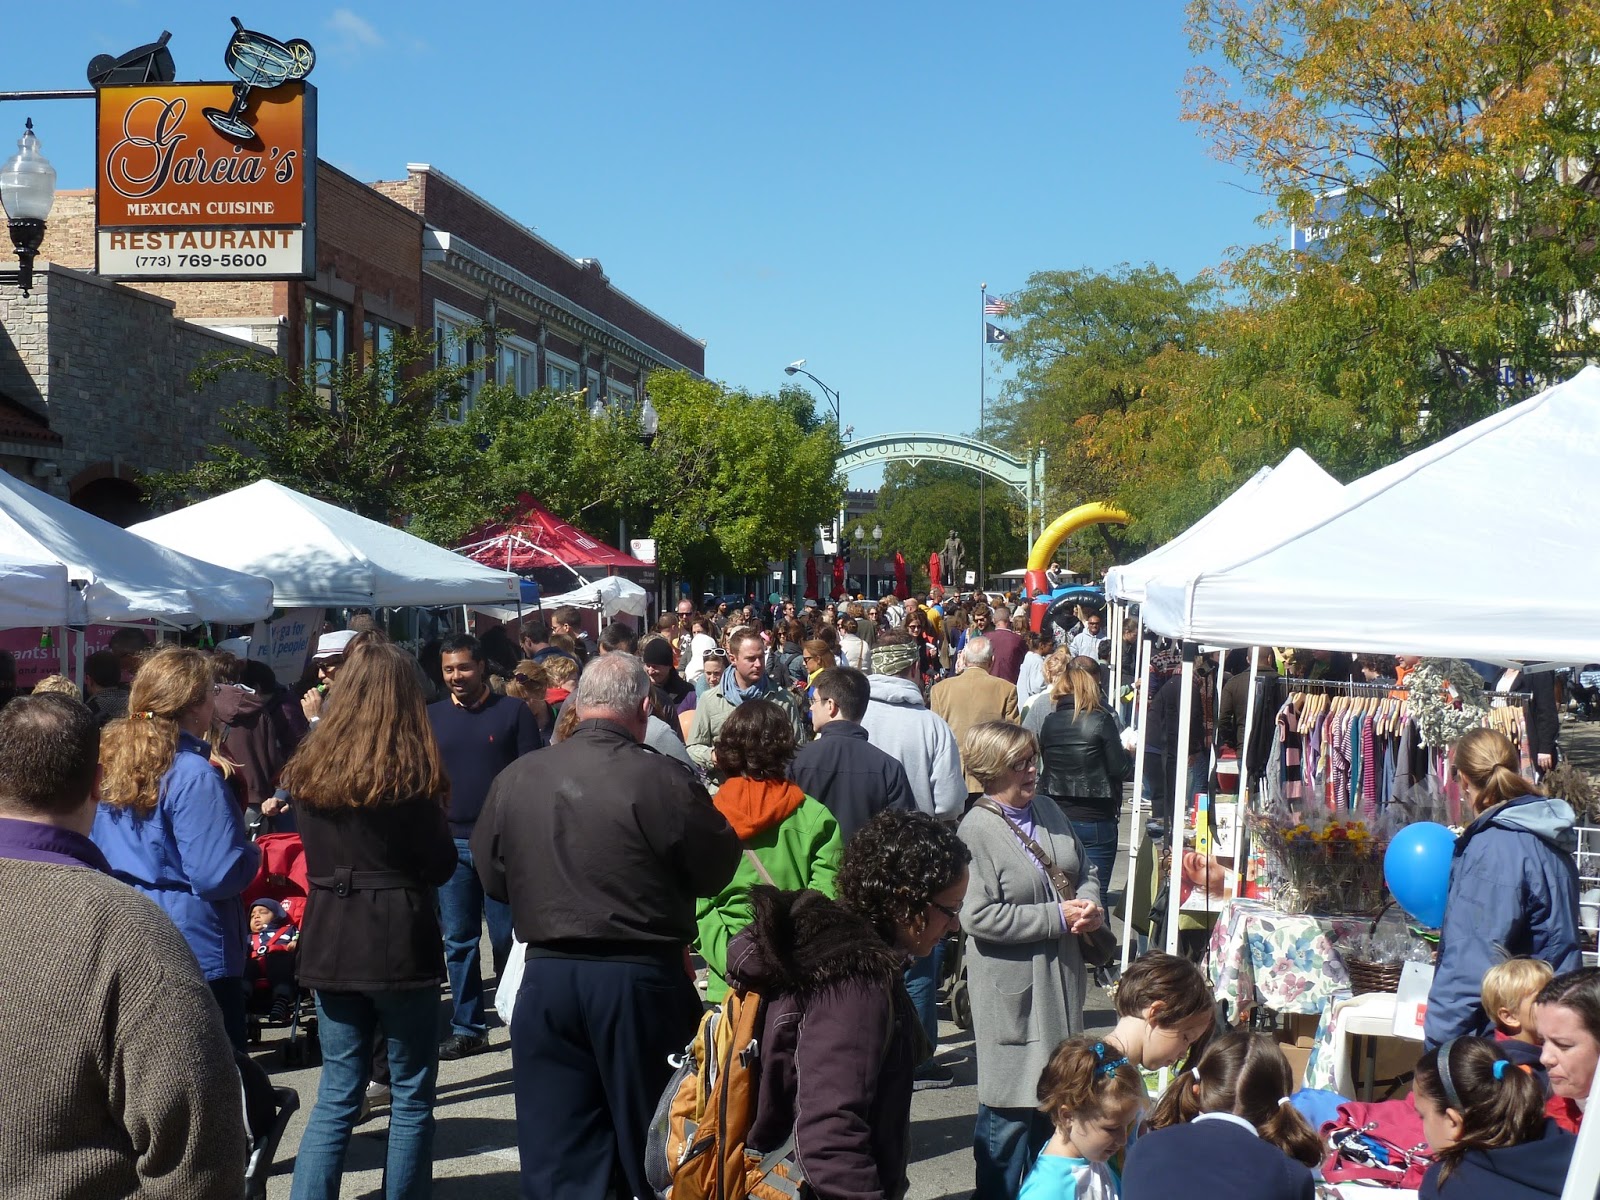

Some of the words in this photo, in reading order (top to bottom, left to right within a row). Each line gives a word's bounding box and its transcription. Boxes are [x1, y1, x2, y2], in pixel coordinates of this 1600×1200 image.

[106, 96, 297, 199] Garcia's
[127, 202, 201, 216] MEXICAN
[206, 201, 275, 215] CUISINE
[110, 230, 294, 250] RESTAURANT
[135, 255, 171, 268] (773)
[177, 253, 267, 268] 769-5600
[836, 442, 915, 468] INCOLN
[925, 442, 998, 468] SQUARE
[98, 628, 118, 636] Sinc
[292, 621, 305, 636] for
[12, 646, 48, 660] ants
[257, 640, 277, 656] rel
[276, 637, 309, 657] people!
